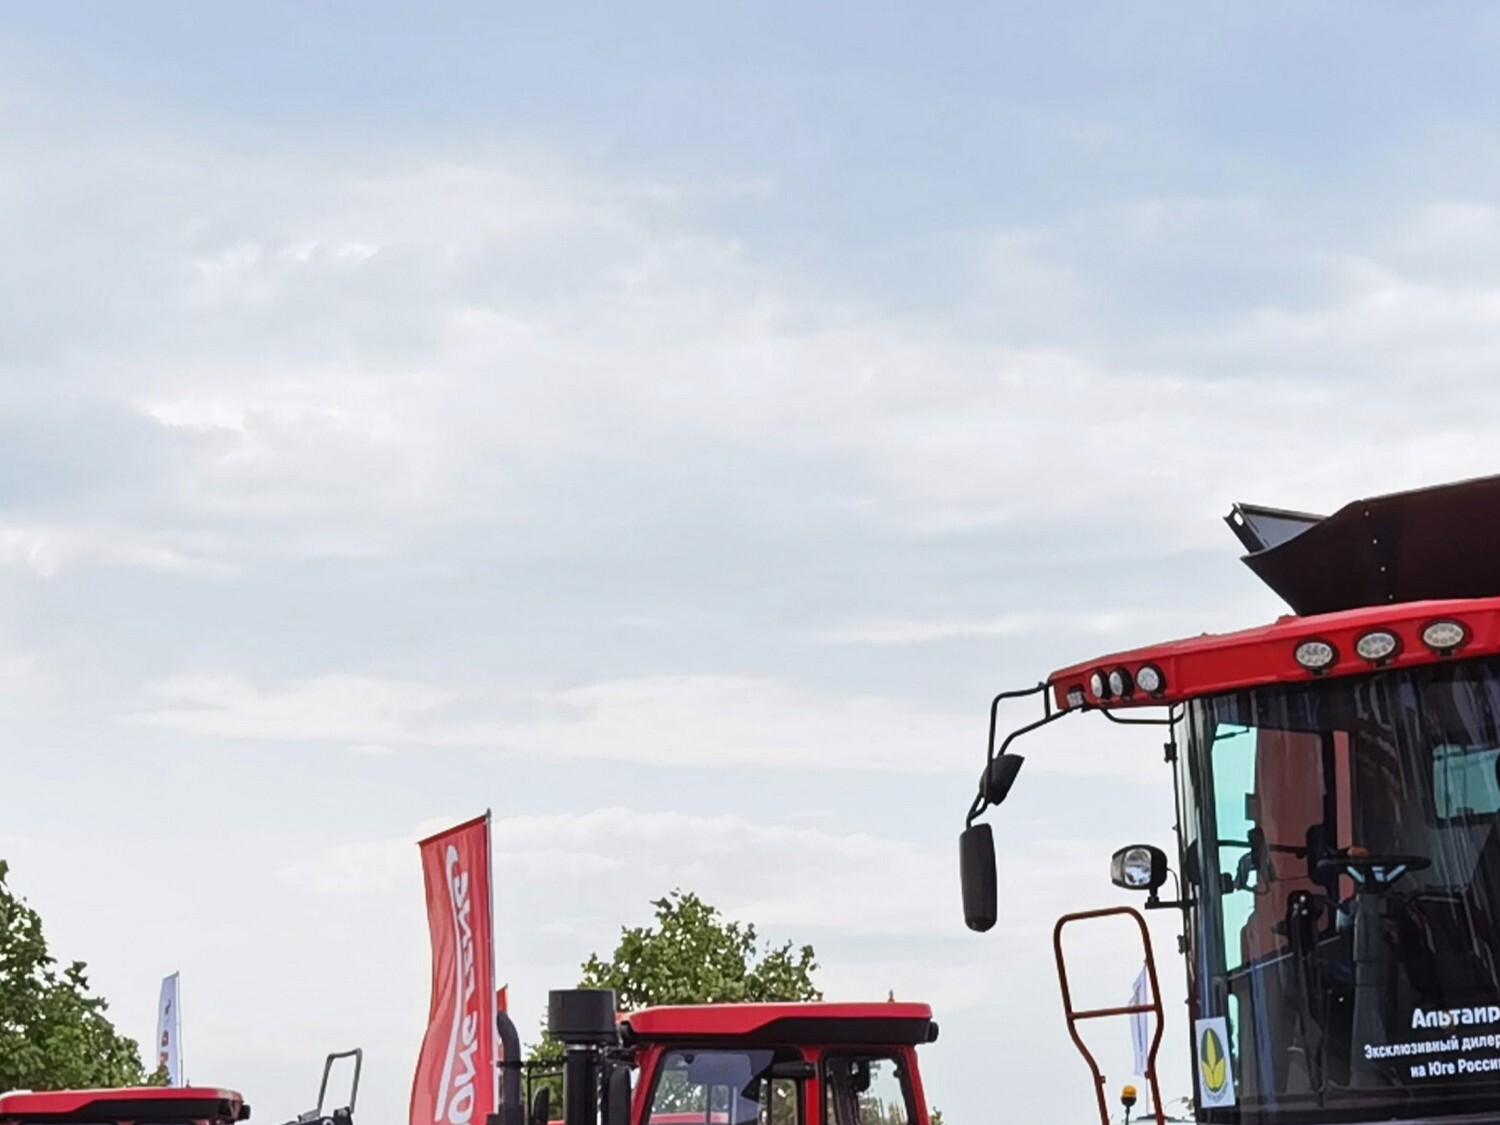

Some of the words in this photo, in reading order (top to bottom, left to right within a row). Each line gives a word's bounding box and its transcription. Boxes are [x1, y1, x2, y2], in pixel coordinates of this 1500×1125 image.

[1411, 1006, 1500, 1029] Альтаир
[1364, 1036, 1460, 1059] Эксклюзивный
[1410, 1065, 1426, 1078] на
[1428, 1061, 1456, 1077] Юге
